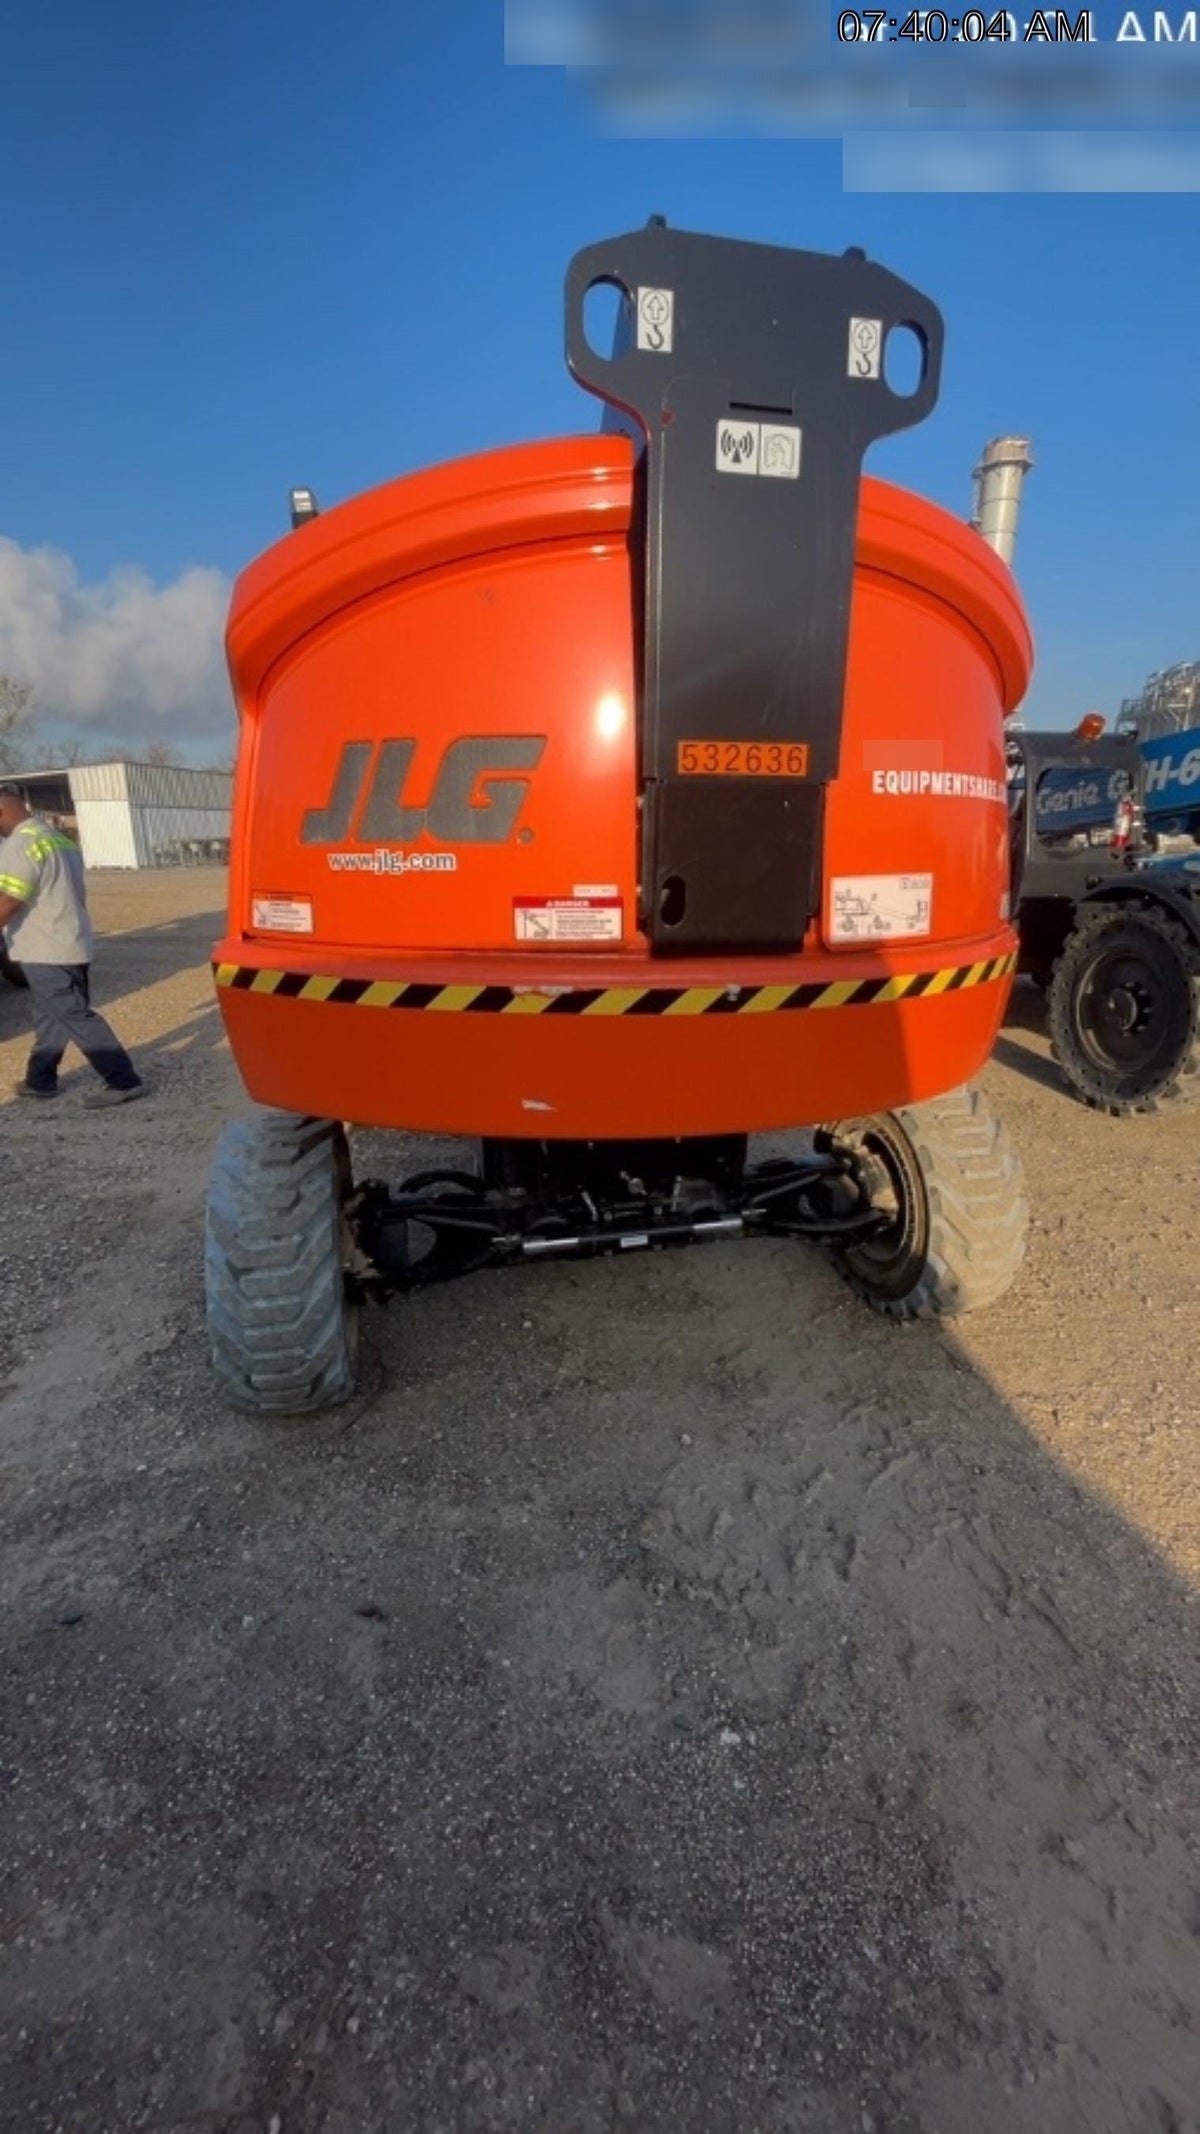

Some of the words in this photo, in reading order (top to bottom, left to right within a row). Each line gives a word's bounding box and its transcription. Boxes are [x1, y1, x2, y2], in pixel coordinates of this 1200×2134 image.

[682, 743, 804, 774] 532636
[301, 735, 547, 843] JLG
[328, 850, 457, 875] www.jlg.com
